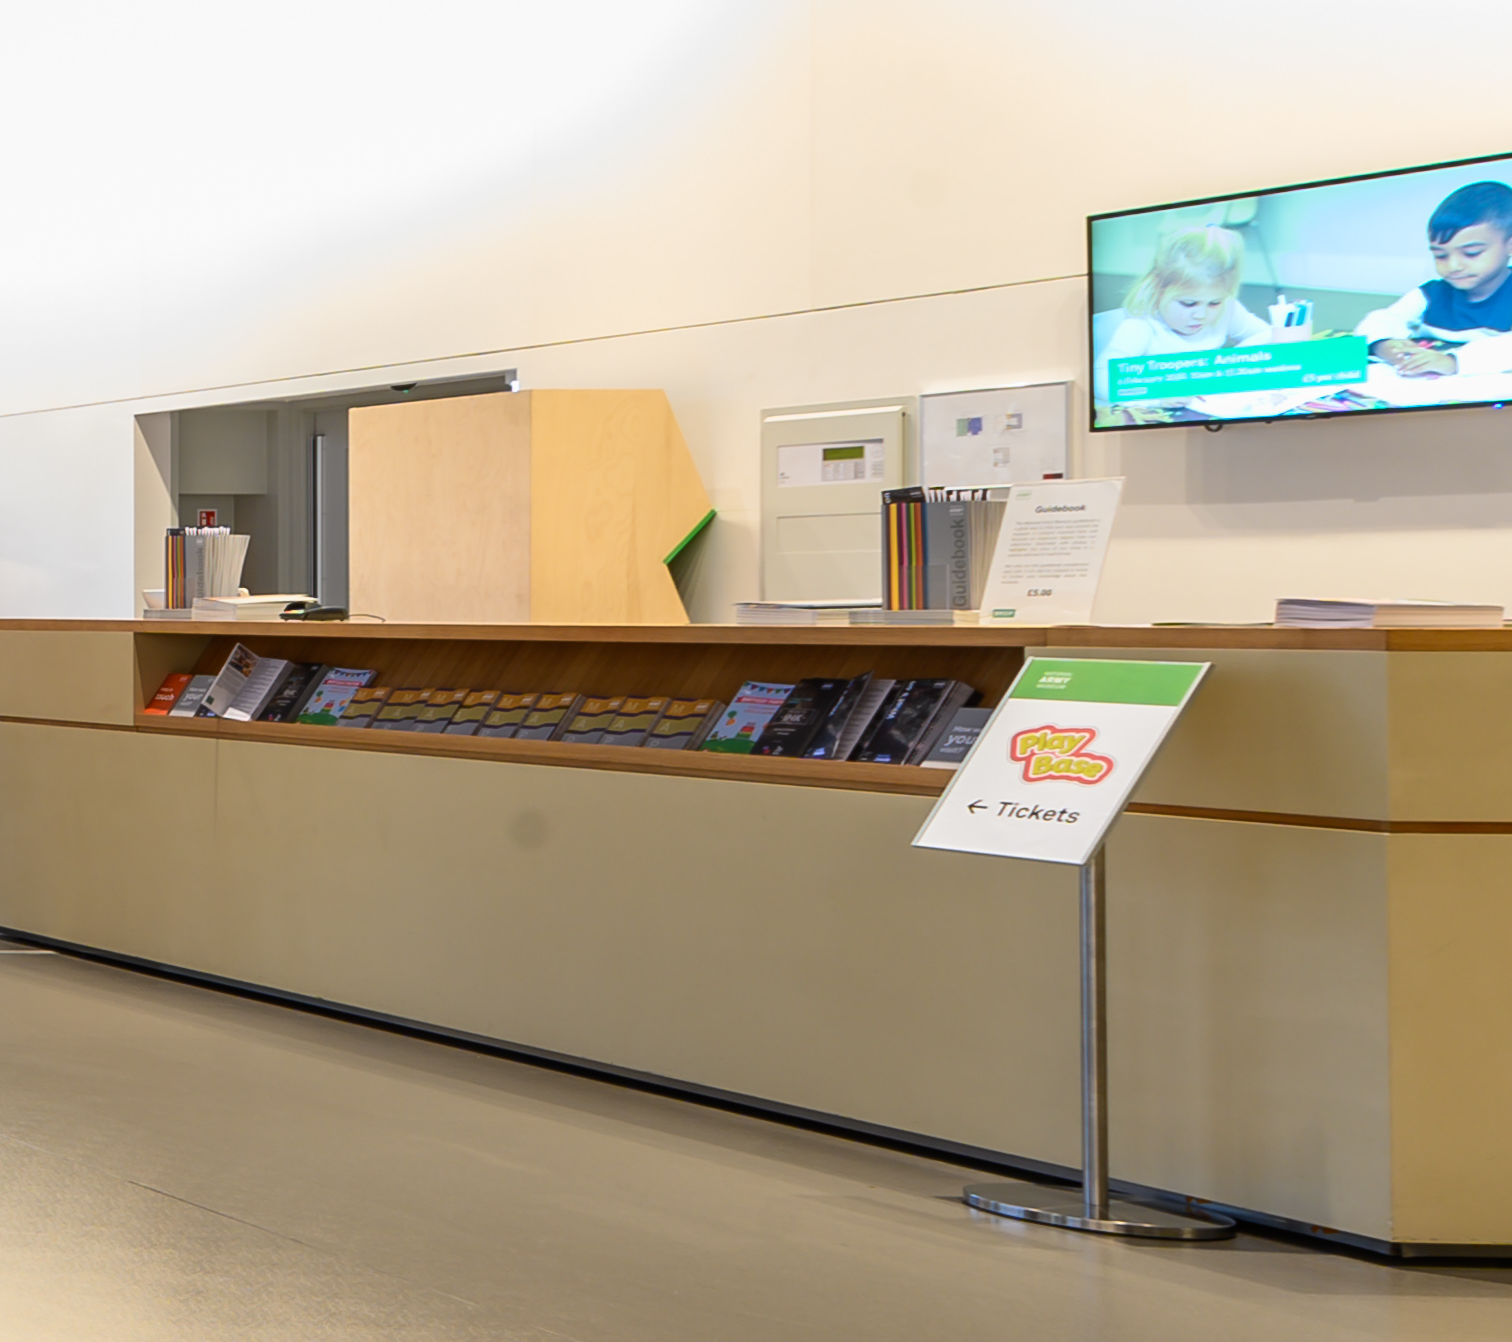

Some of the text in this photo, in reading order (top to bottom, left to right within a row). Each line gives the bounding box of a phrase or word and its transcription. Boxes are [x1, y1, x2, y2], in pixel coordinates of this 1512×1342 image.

[1117, 351, 1273, 375] Tiny Troopers: Animals
[1035, 504, 1086, 513] Guidebook
[950, 519, 967, 608] Guidebook
[1019, 730, 1087, 755] Play
[1031, 755, 1104, 778] Base
[996, 800, 1081, 824] Tickets
